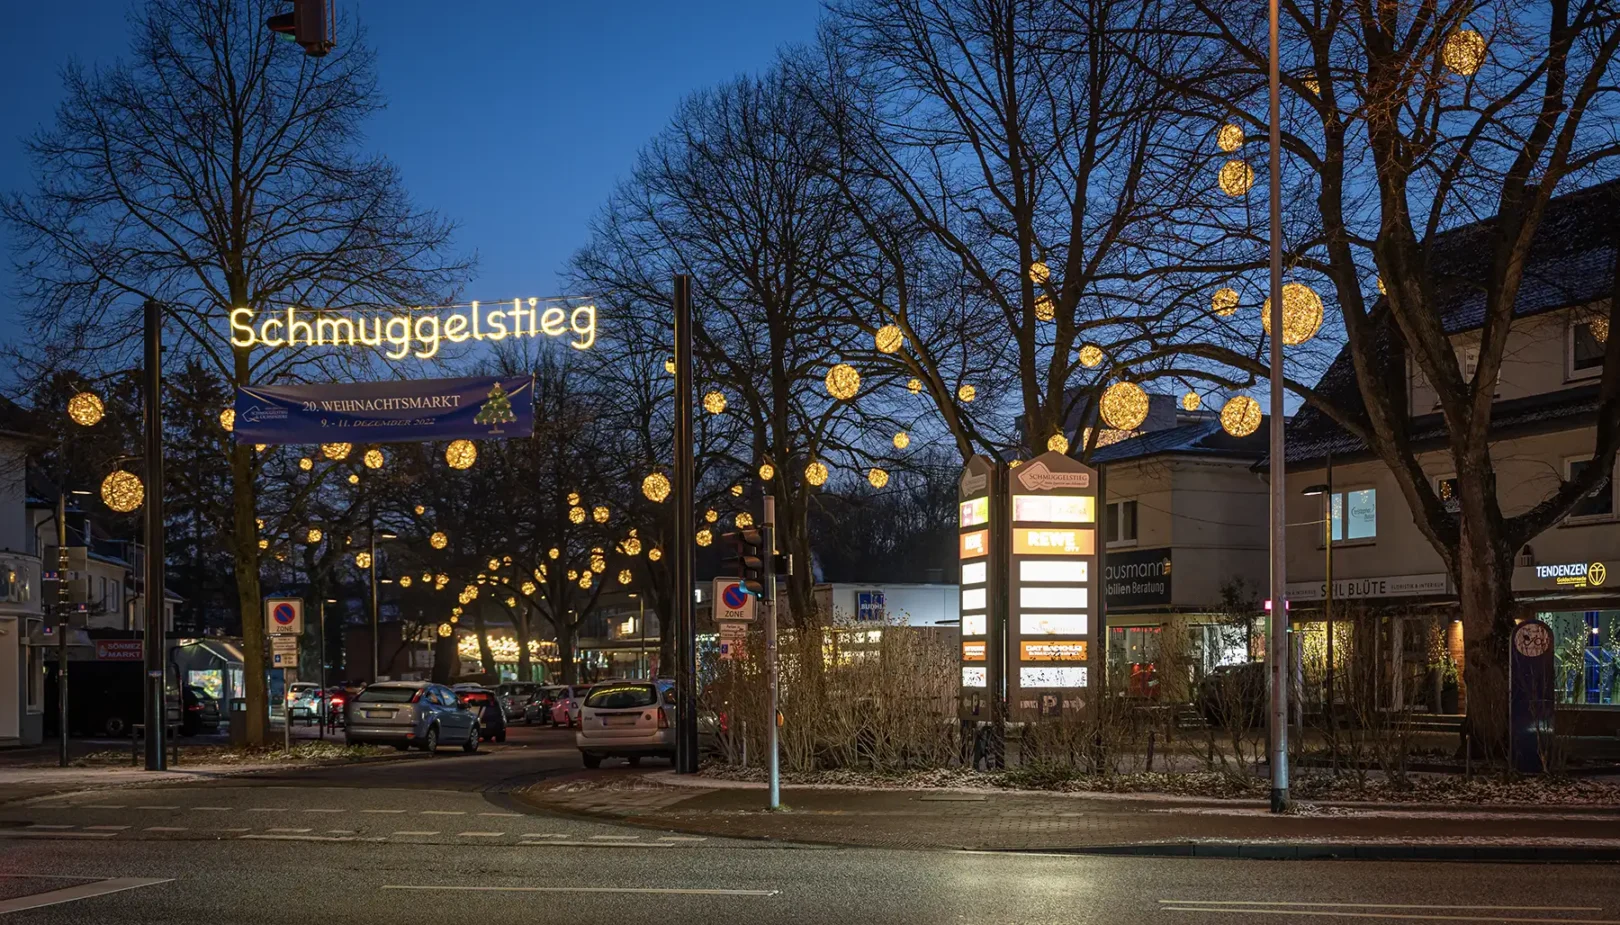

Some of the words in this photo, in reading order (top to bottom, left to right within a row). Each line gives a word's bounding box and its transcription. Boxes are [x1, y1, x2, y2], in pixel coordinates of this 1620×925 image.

[230, 297, 597, 360] Schmuggelstieg
[302, 401, 320, 411] 20.
[321, 395, 461, 411] WEIHNACHTSMARKT
[320, 419, 330, 428] 9.
[338, 419, 351, 428] 11.
[352, 419, 411, 427] DEZEMBER
[412, 417, 436, 426] 2022
[1029, 473, 1088, 481] SCHMUGGELSTIEG
[1028, 531, 1075, 546] REWE
[1536, 563, 1587, 578] TENDENZEN
[1106, 583, 1131, 596] bilien
[1132, 581, 1165, 595] Beratung
[1349, 579, 1386, 595] BLÜTE
